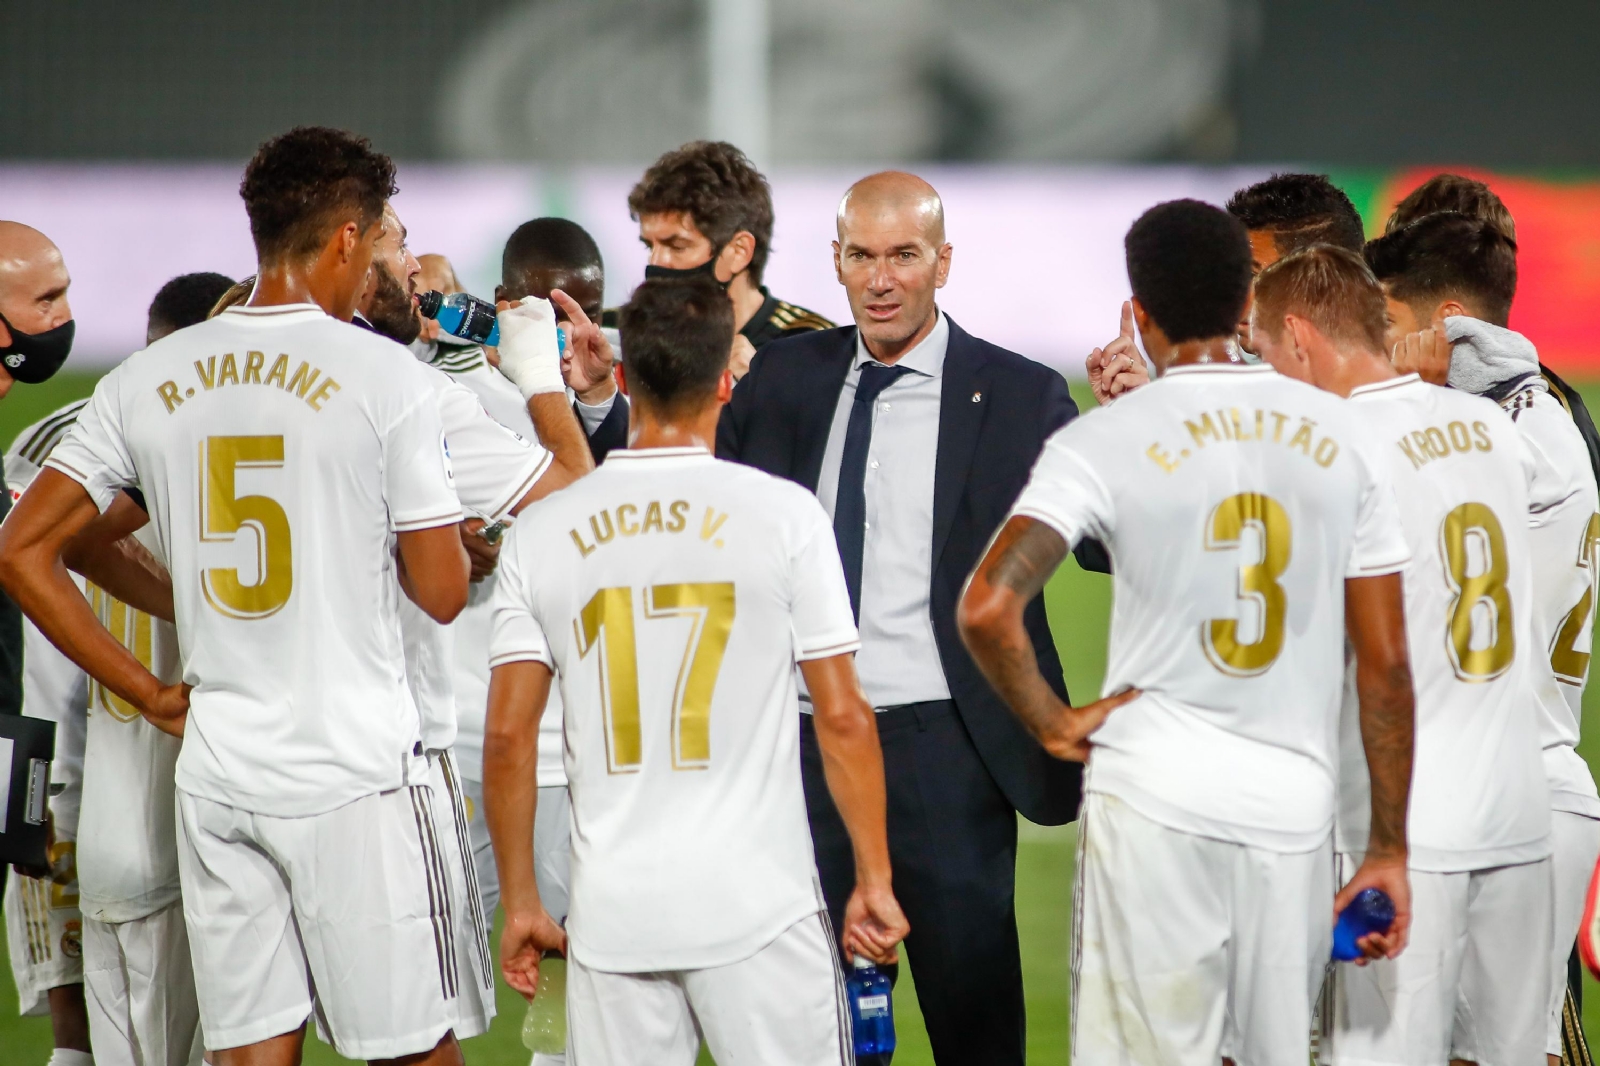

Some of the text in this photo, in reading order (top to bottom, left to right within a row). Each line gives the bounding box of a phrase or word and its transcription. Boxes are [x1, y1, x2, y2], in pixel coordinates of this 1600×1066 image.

[198, 434, 293, 621] 5
[569, 500, 730, 559] LUCAS V.
[1396, 420, 1493, 471] KROOS
[1199, 491, 1293, 678] 3
[1438, 501, 1516, 684] 8
[573, 581, 737, 776] 17
